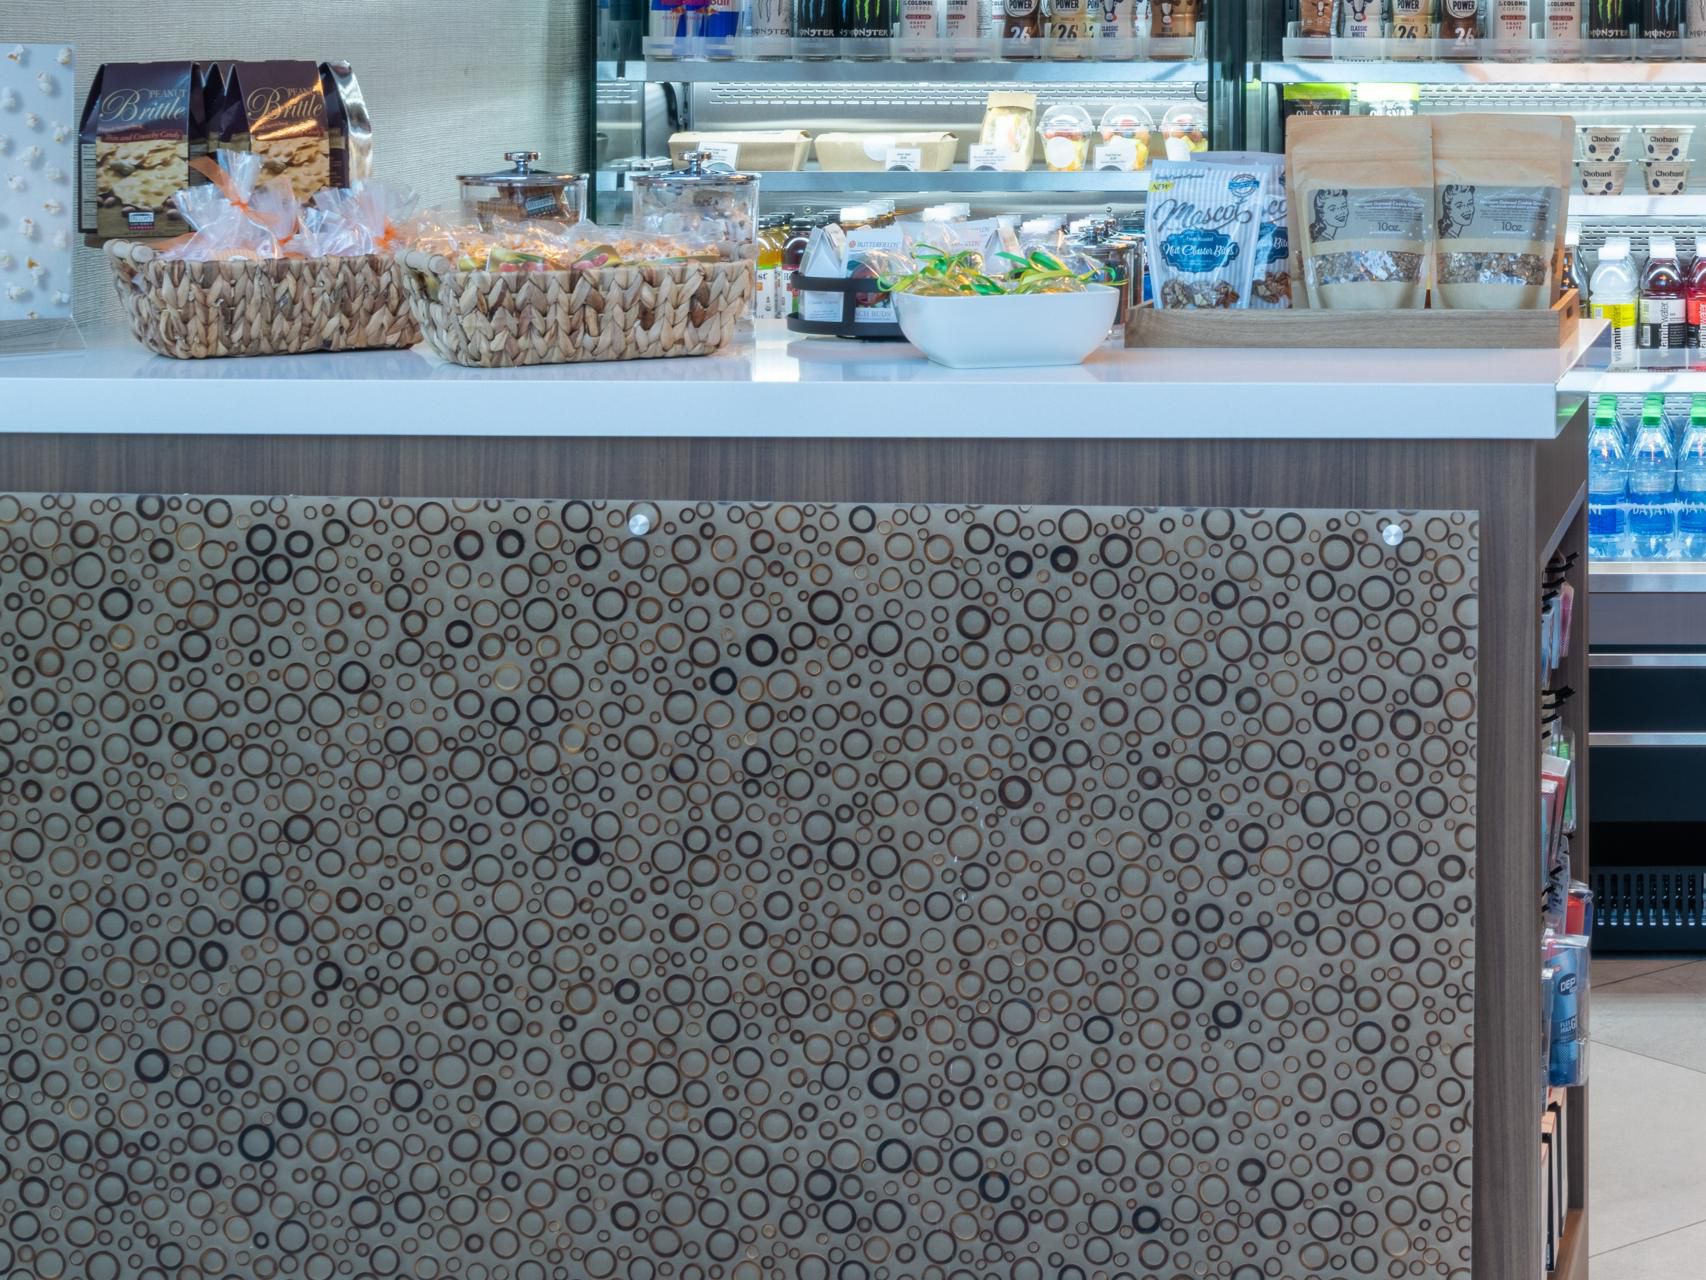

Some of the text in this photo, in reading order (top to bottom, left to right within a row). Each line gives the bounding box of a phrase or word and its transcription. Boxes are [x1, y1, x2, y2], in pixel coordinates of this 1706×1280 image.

[1008, 0, 1033, 10] POWER
[1055, 0, 1080, 10] POWER
[1397, 0, 1420, 10] POWER
[1452, 0, 1476, 11] POWER
[149, 88, 187, 99] PEANUT
[99, 87, 187, 122] Brittle
[246, 86, 324, 122] Brittle
[1591, 135, 1621, 144] Chobani
[1650, 135, 1679, 144] Chobani
[1583, 170, 1612, 178] Chobani
[1655, 170, 1685, 178] Chobani
[1151, 198, 1253, 233] Mascot
[1163, 244, 1181, 256] Nut
[1181, 243, 1213, 256] Cluster
